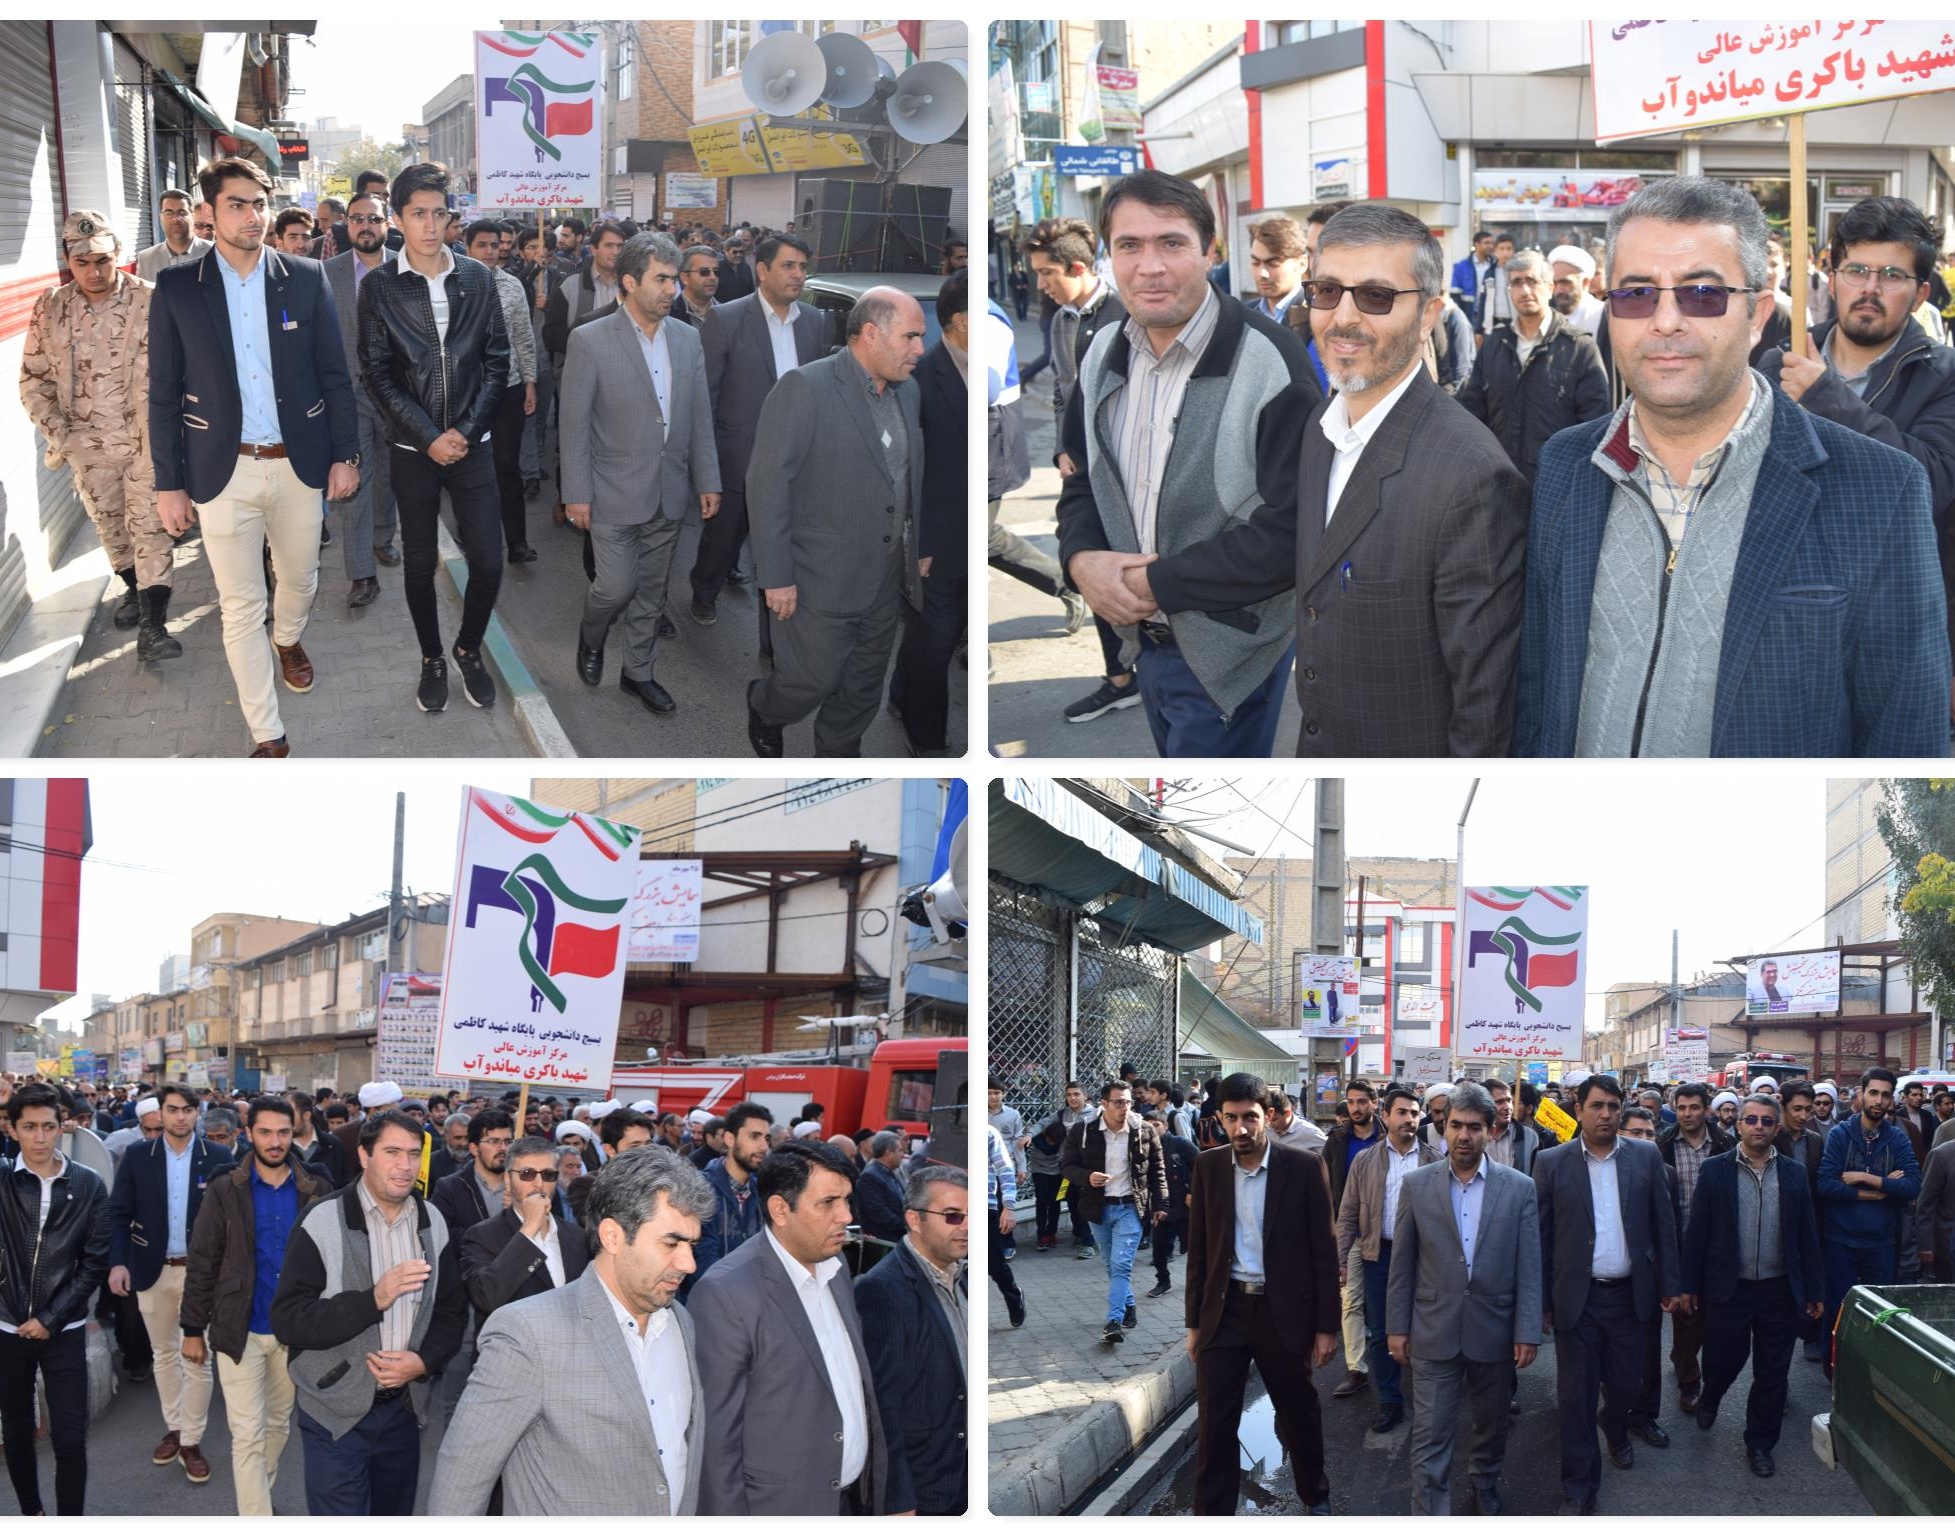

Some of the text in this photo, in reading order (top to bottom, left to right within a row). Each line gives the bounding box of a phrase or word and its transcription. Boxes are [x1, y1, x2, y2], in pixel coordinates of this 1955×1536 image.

[1697, 31, 1742, 64] عالی
[1877, 33, 1955, 84] شهید
[1775, 48, 1866, 102] باکری
[742, 129, 756, 144] 4G
[537, 194, 562, 206] باکری
[453, 1015, 602, 1047] بسیج دانشجویی پایگاه شهید کاظمی
[1465, 1019, 1487, 1030] کاظمی
[1487, 1019, 1503, 1030] شهید
[1503, 1020, 1521, 1031] پایگاه
[493, 1041, 568, 1061] مرکز آموزش عالی
[1514, 1045, 1540, 1058] باکری
[1542, 1047, 1563, 1058] شهید
[523, 1063, 559, 1082] باکری
[561, 1067, 589, 1083] شهید
